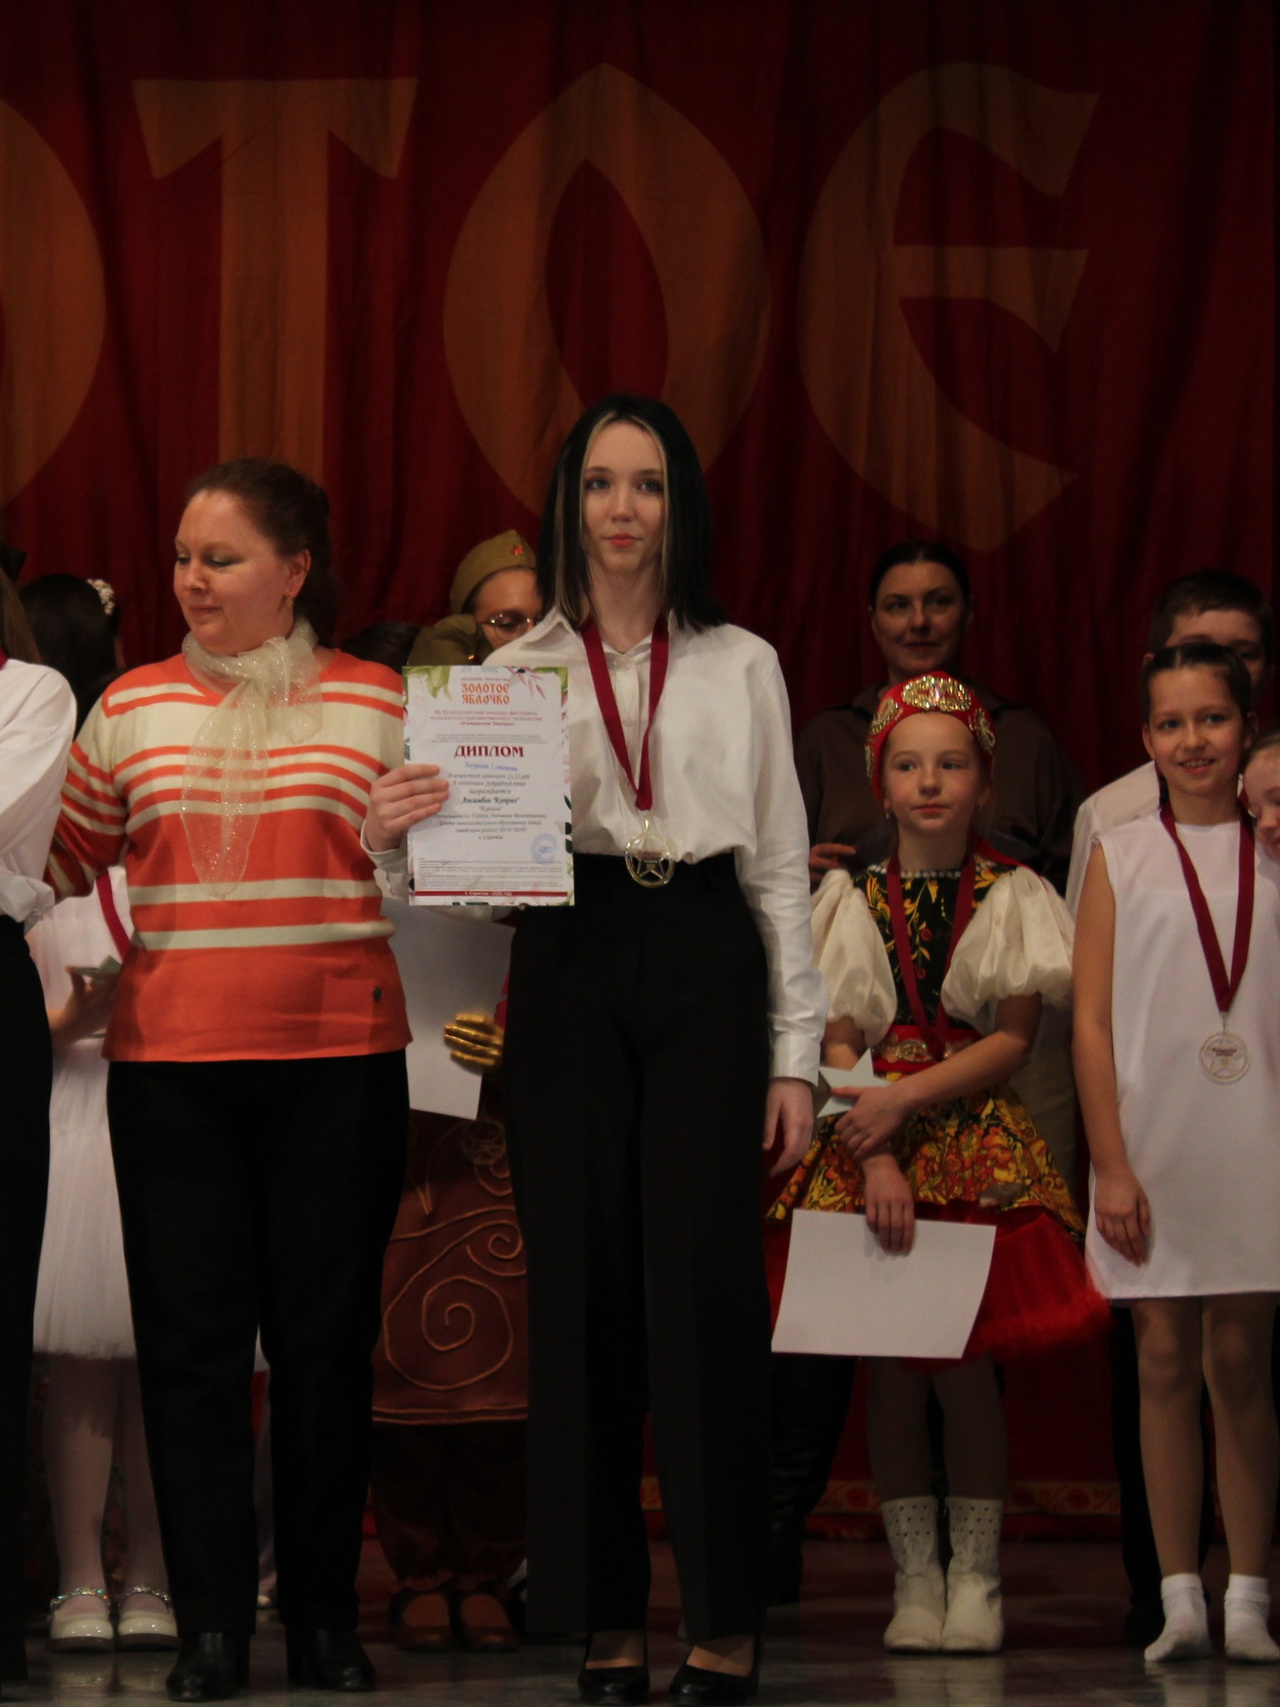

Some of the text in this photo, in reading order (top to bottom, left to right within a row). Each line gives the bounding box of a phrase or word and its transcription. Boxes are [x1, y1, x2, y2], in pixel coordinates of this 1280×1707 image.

[461, 683, 509, 694] ЗОЛОТОЕ
[462, 694, 510, 705] ЯБЛОЧКО
[454, 745, 524, 758] ДИПЛОМ
